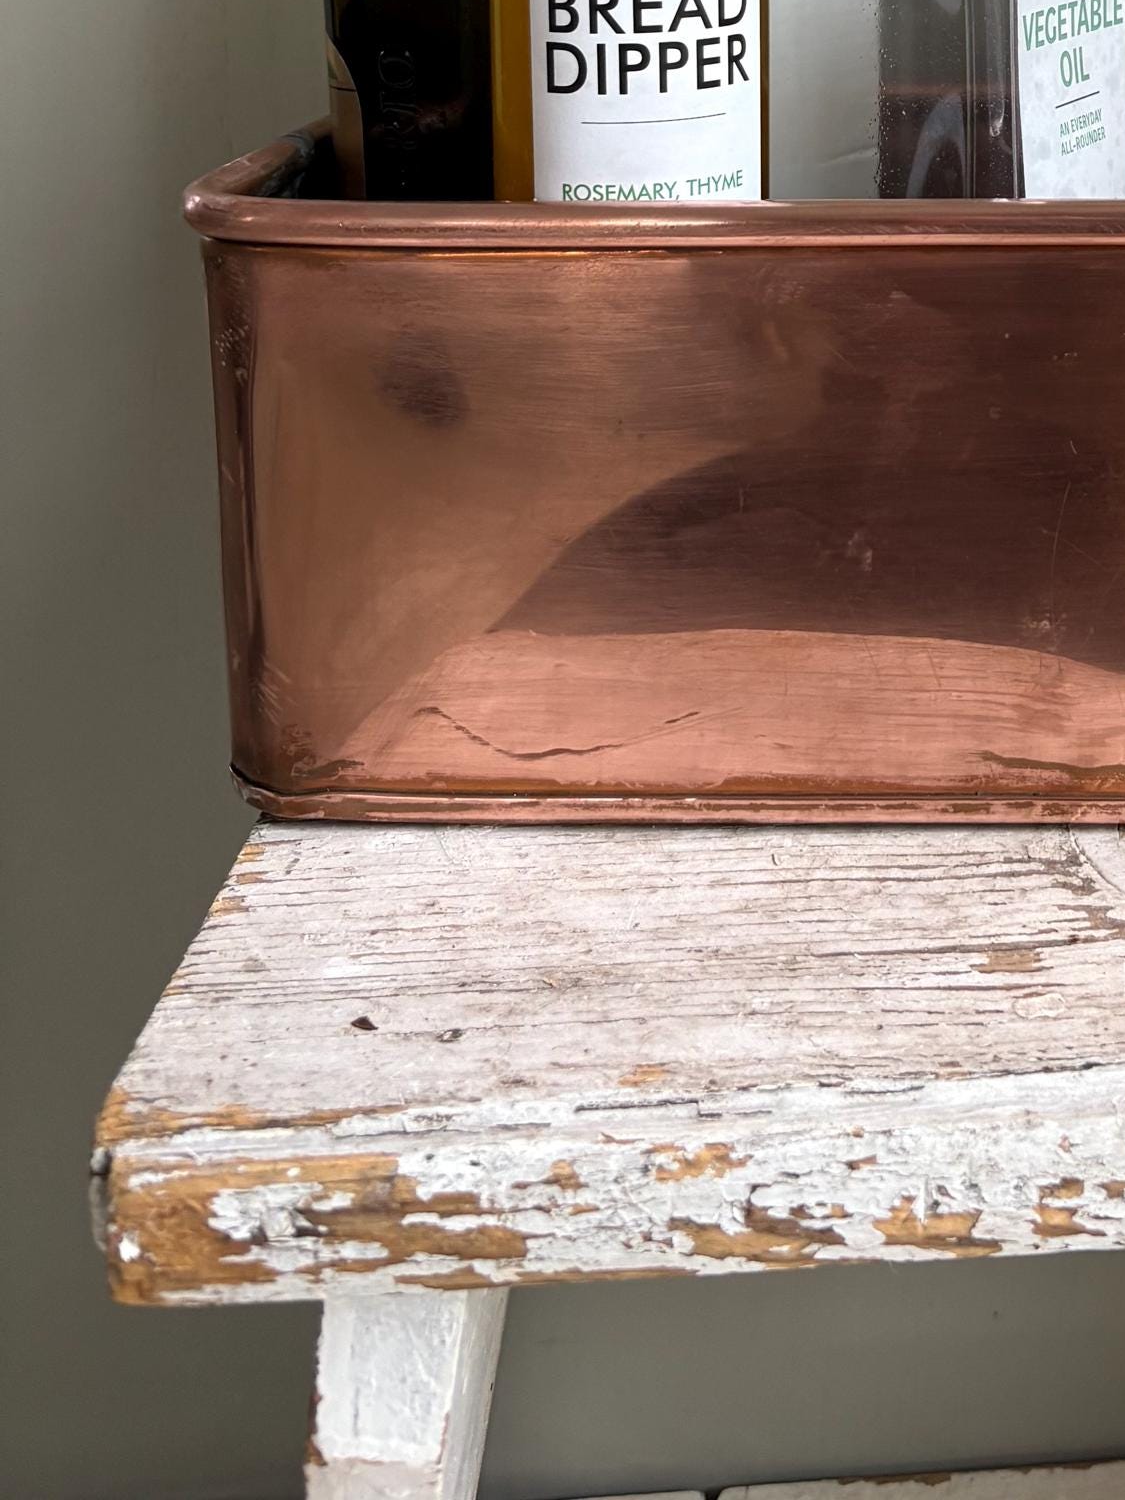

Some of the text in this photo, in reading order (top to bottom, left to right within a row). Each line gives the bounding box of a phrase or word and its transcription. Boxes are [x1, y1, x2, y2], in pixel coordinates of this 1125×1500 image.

[546, 33, 750, 95] DIPPER
[1060, 46, 1090, 88] OIL
[1060, 108, 1102, 138] AN EVERYDAY
[1061, 126, 1106, 157] ALL-ROUNDER
[562, 169, 744, 202] ROSEMARY, THYME
